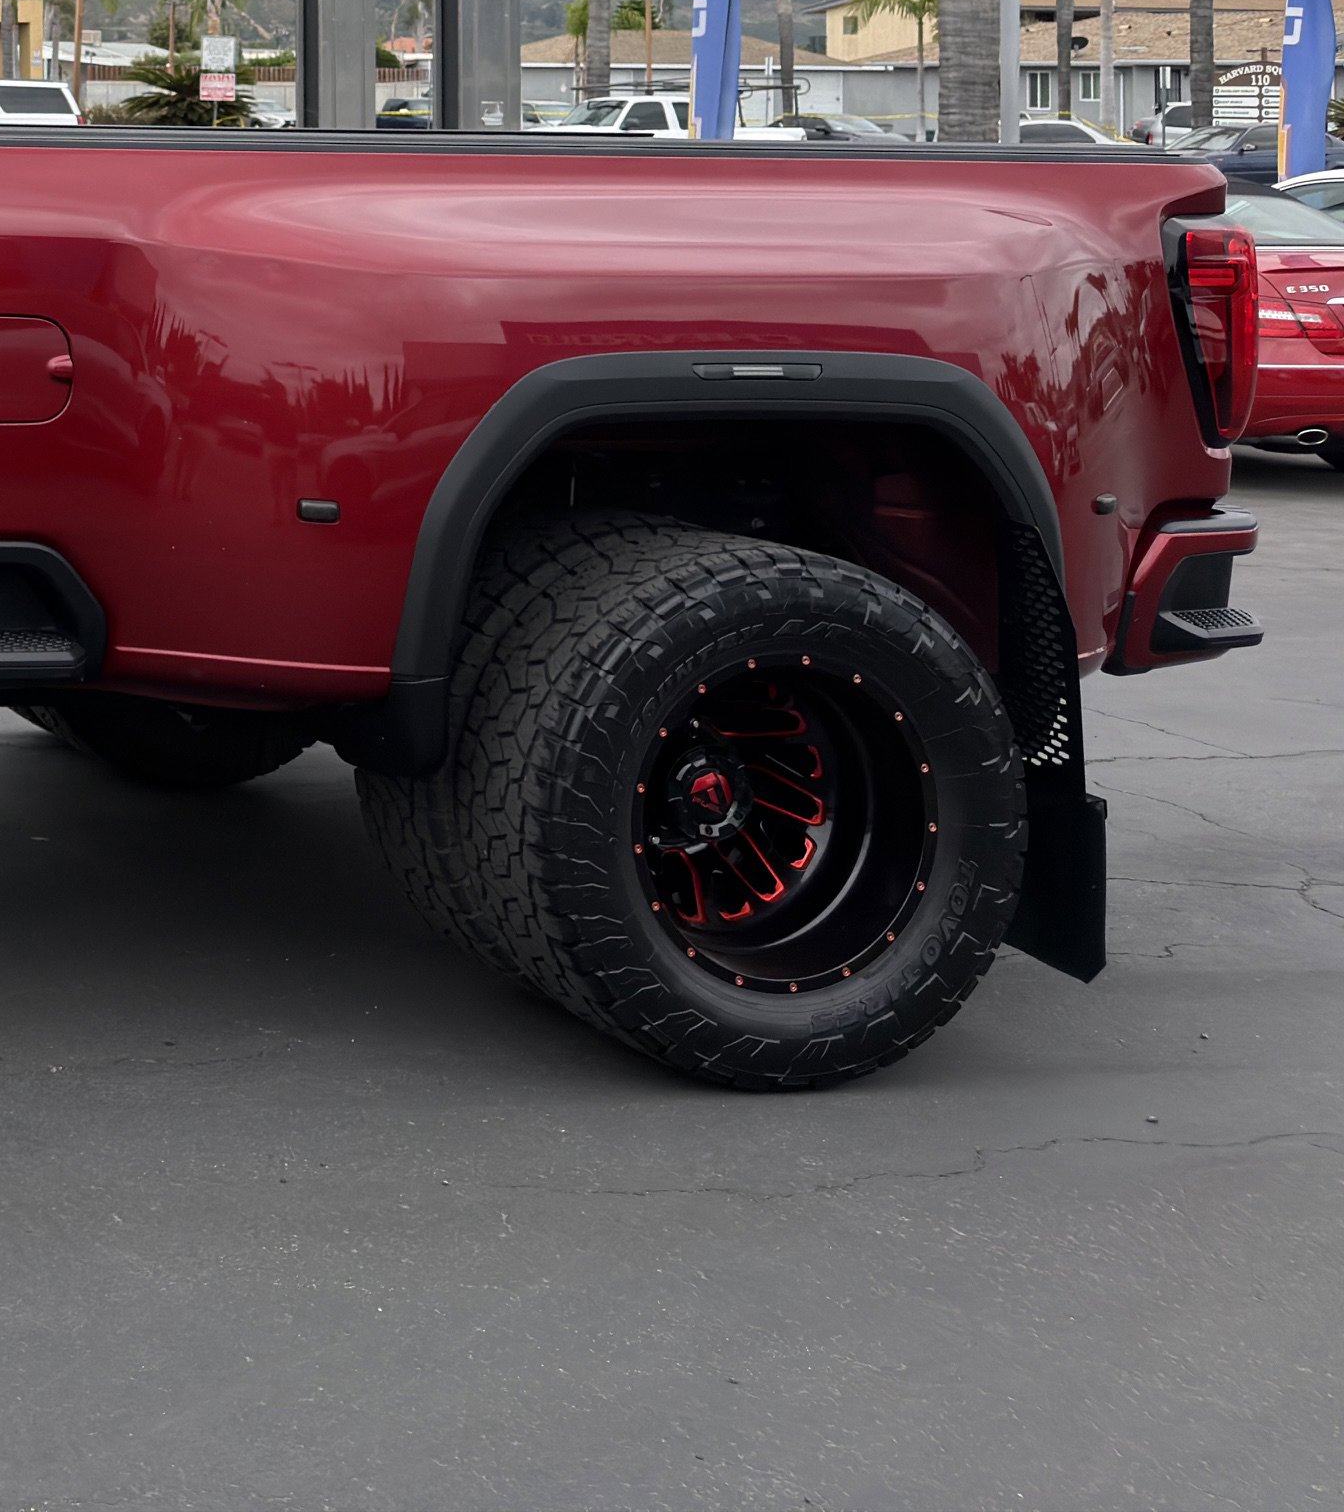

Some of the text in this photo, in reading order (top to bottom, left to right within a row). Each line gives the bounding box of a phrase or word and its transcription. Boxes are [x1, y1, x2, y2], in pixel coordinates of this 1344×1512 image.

[1218, 64, 1264, 85] HARVARD
[1251, 74, 1270, 86] 110
[1299, 284, 1330, 293] 350
